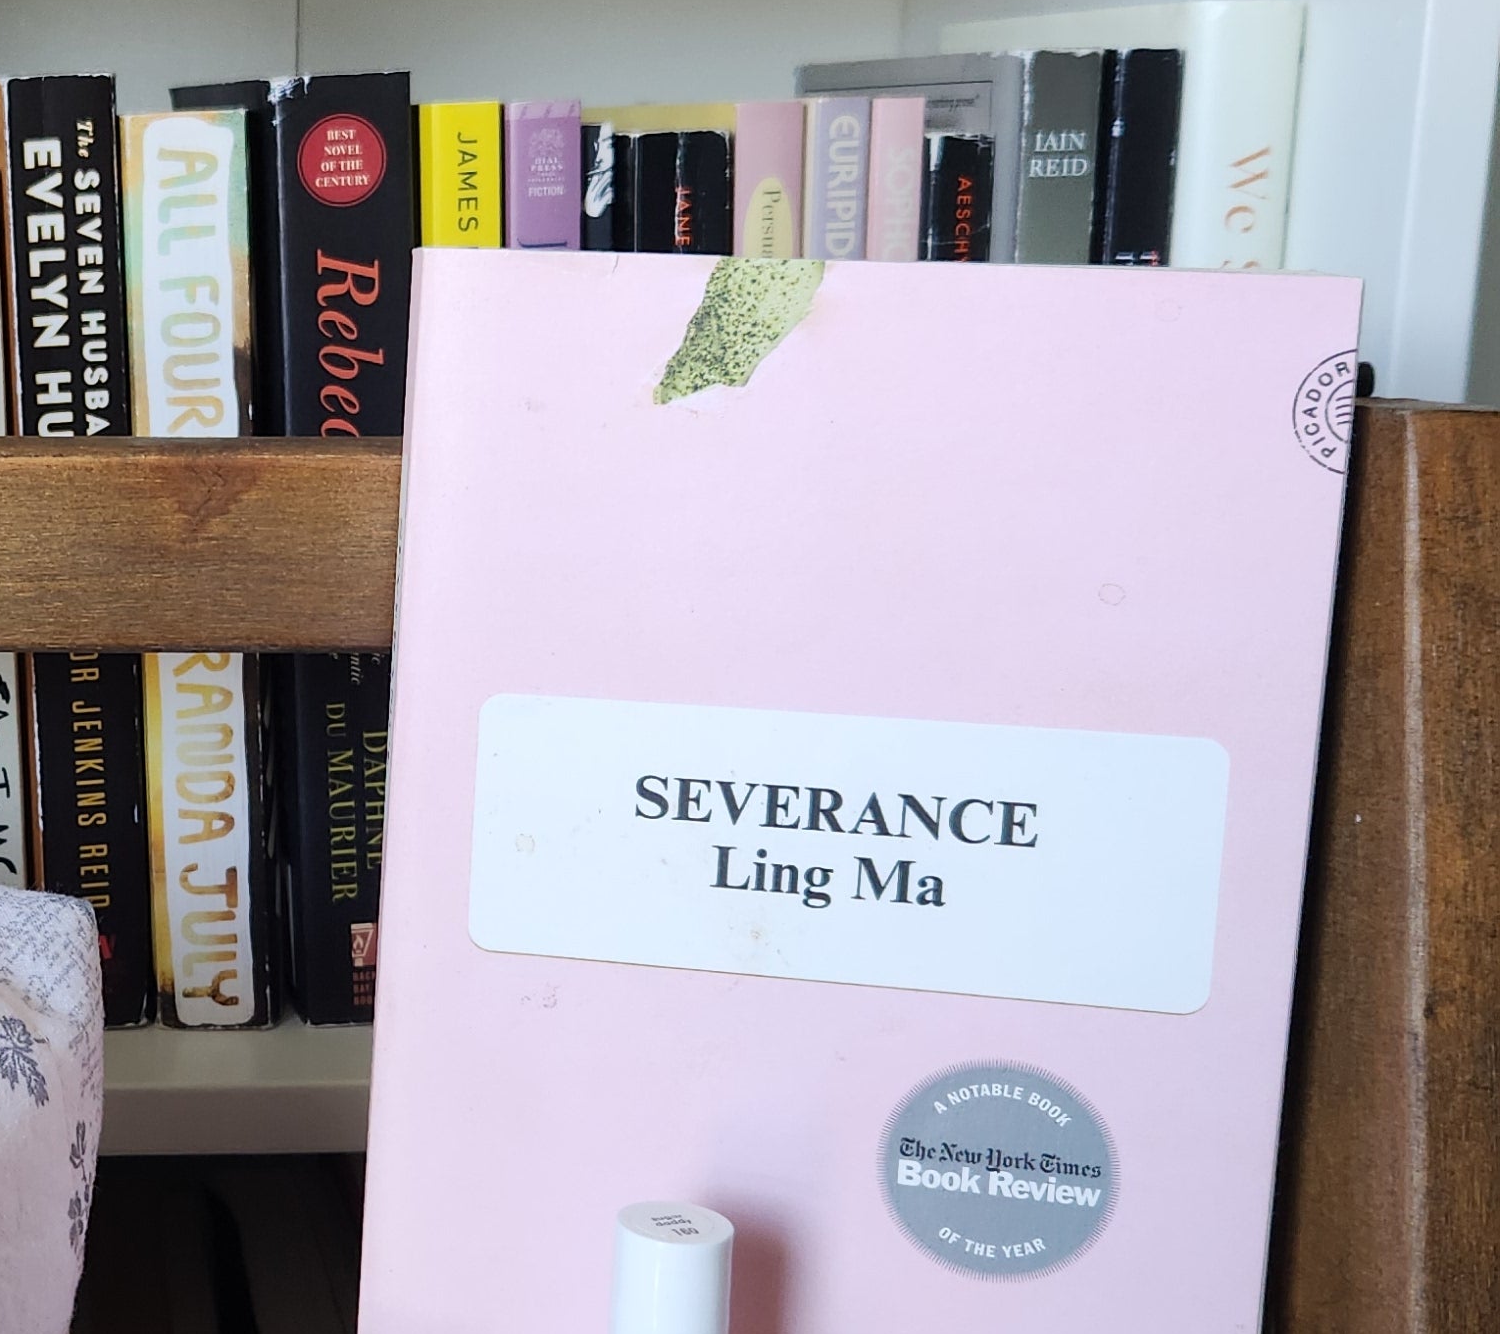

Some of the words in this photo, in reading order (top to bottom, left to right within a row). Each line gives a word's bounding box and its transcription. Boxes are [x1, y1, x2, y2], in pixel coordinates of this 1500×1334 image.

[76, 118, 95, 159] The
[323, 144, 364, 157] NOVEL
[325, 128, 357, 142] BEST
[1034, 131, 1087, 152] IAIN
[314, 173, 371, 189] CENTURY
[320, 161, 337, 173] OF
[338, 159, 364, 172] THE
[456, 131, 479, 234] JAMES
[528, 185, 565, 197] FICTION
[1028, 157, 1088, 178] REID
[156, 146, 219, 256] ALL
[674, 186, 692, 247] JANE
[22, 137, 71, 349] EVELYN
[74, 168, 105, 294] SEVEN
[1300, 361, 1351, 460] PICADOR
[325, 701, 347, 737] DU
[72, 699, 108, 827] JENKINS
[328, 748, 359, 903] MAURIER
[633, 773, 1039, 849] SEVERANCE
[79, 843, 111, 908] REID
[710, 844, 834, 909] Ling
[850, 856, 947, 909] Ma
[178, 863, 239, 1007] JULY
[933, 1100, 948, 1114] A
[947, 1083, 1024, 1106] NOTABLE
[1028, 1091, 1072, 1127] BOOK
[899, 1137, 937, 1161] The
[939, 1142, 982, 1165] New
[986, 1148, 1037, 1173] York
[1040, 1153, 1102, 1178] Times
[897, 1158, 981, 1194] Book
[988, 1170, 1102, 1208] Review
[938, 1227, 962, 1245] OF
[964, 1238, 996, 1258] THE
[1002, 1238, 1046, 1258] YEAR
